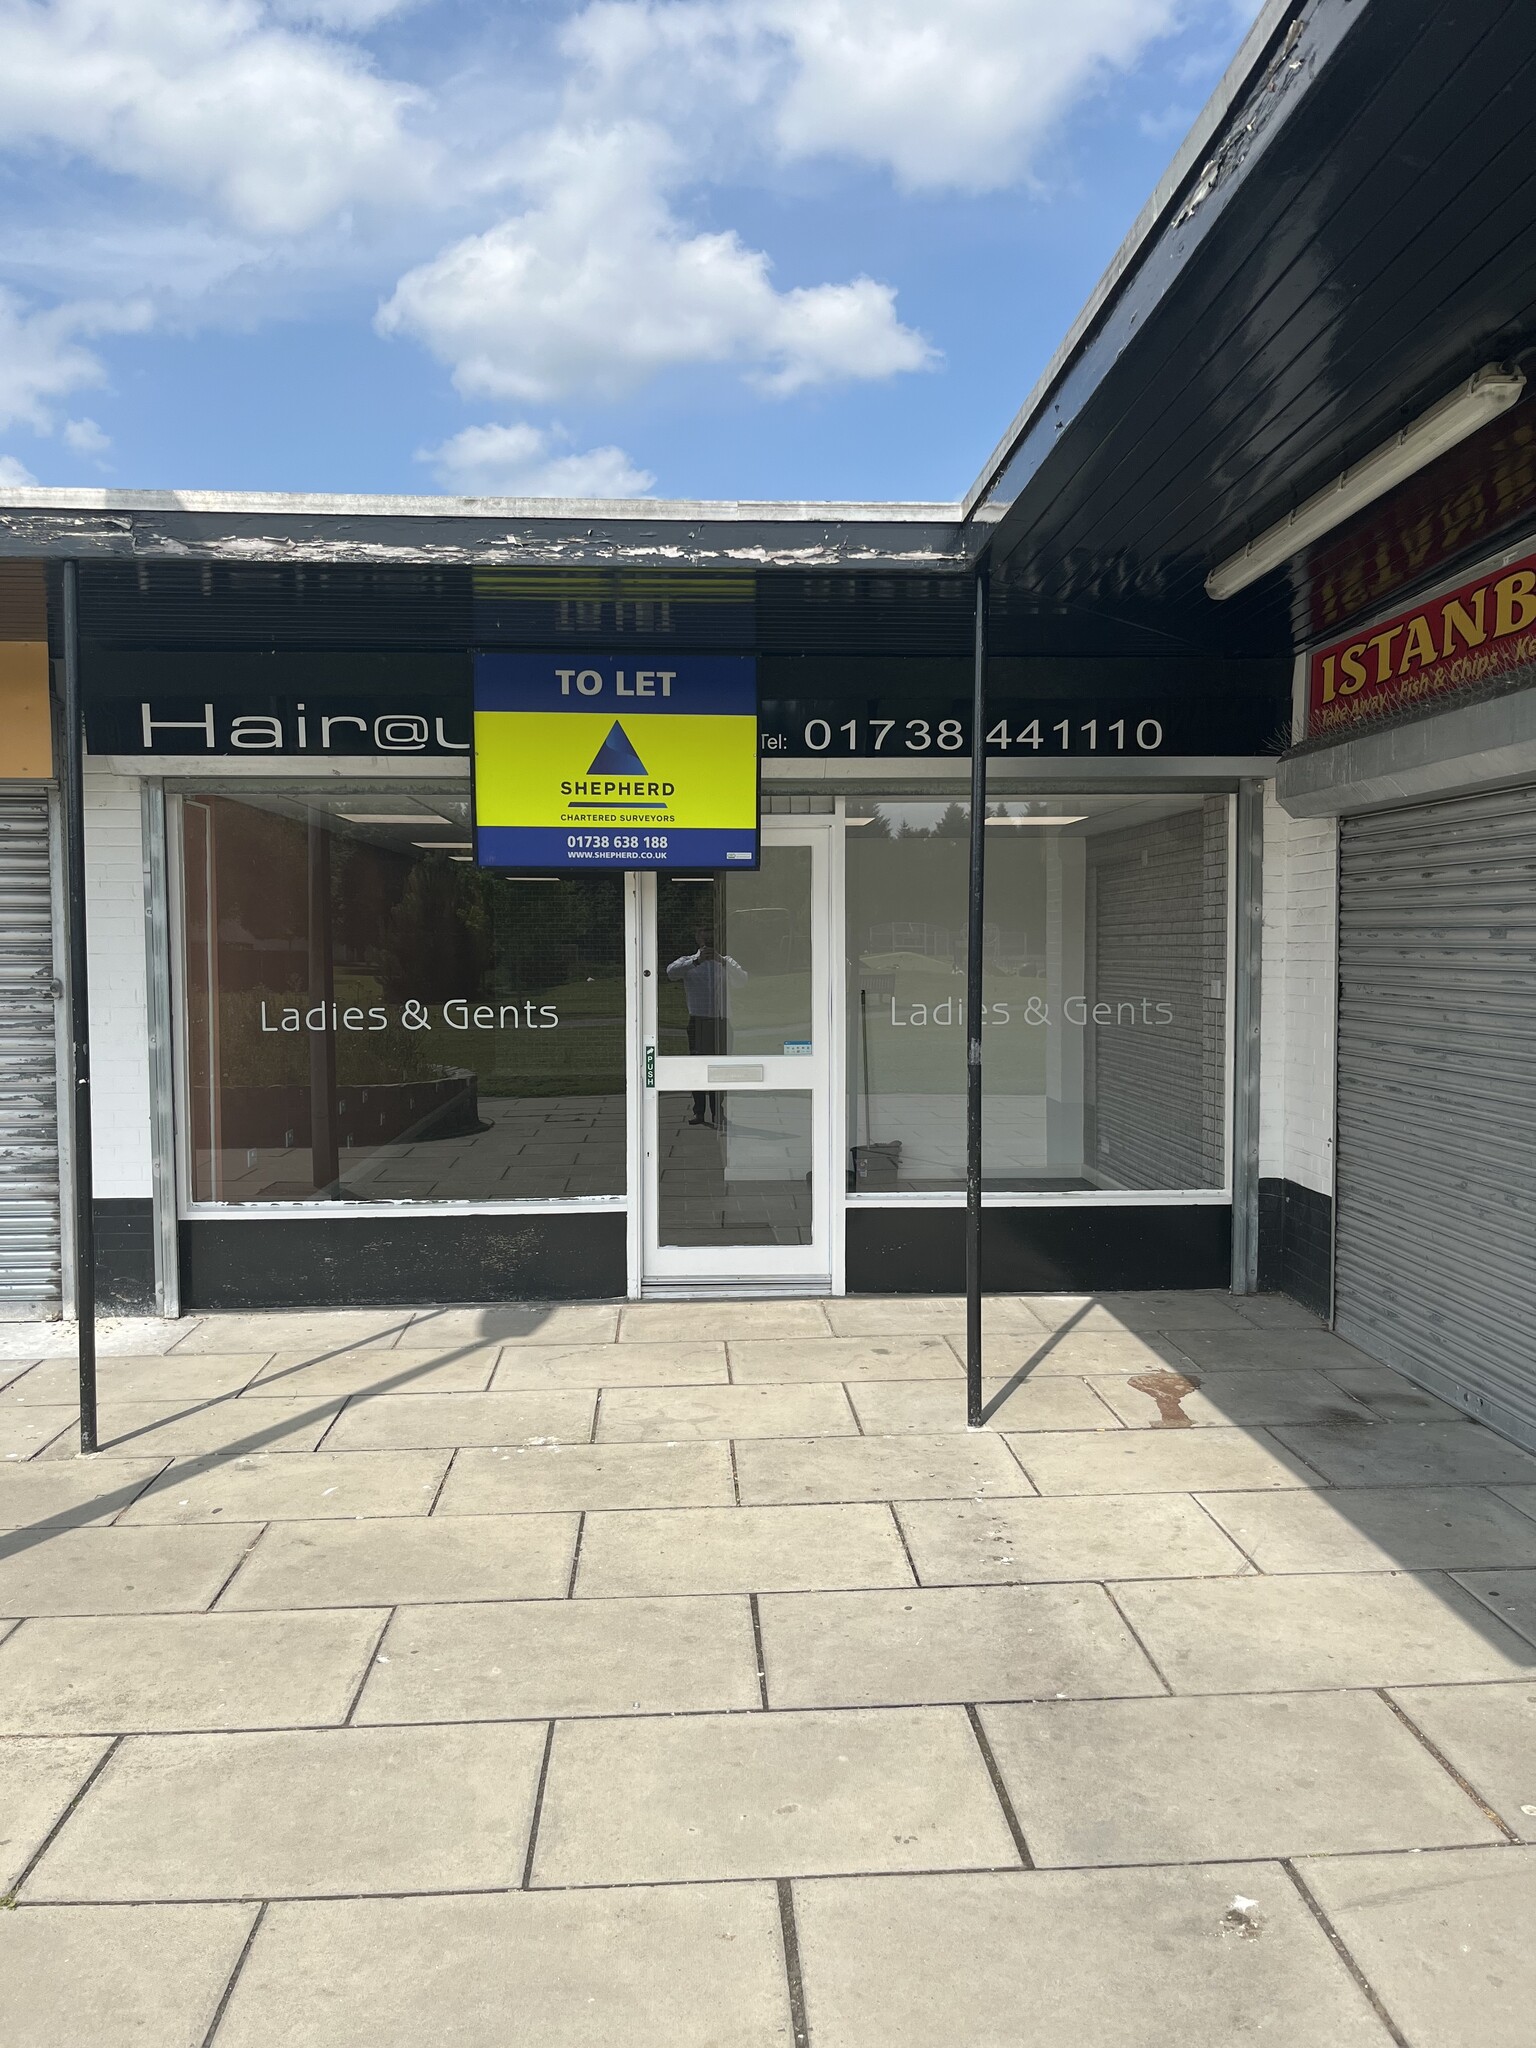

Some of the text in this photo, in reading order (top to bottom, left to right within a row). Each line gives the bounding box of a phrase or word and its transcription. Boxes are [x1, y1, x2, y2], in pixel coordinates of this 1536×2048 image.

[1322, 570, 1536, 705] ISTANB
[555, 669, 677, 697] TO LET
[1400, 673, 1429, 698] Fish
[1433, 667, 1445, 688] &
[1450, 653, 1498, 681] Chips
[761, 719, 1163, 751] Tel: 01738 441110
[560, 781, 675, 796] SHEPHERD
[560, 814, 675, 822] CHARTERED SURVEYORS
[567, 835, 668, 849] 01738 638 188
[567, 851, 667, 860] WWW.SHEPHERD.CO.UK
[261, 999, 559, 1032] Ladies & Gents
[1023, 996, 1051, 1026] &
[1063, 996, 1173, 1026] Gents
